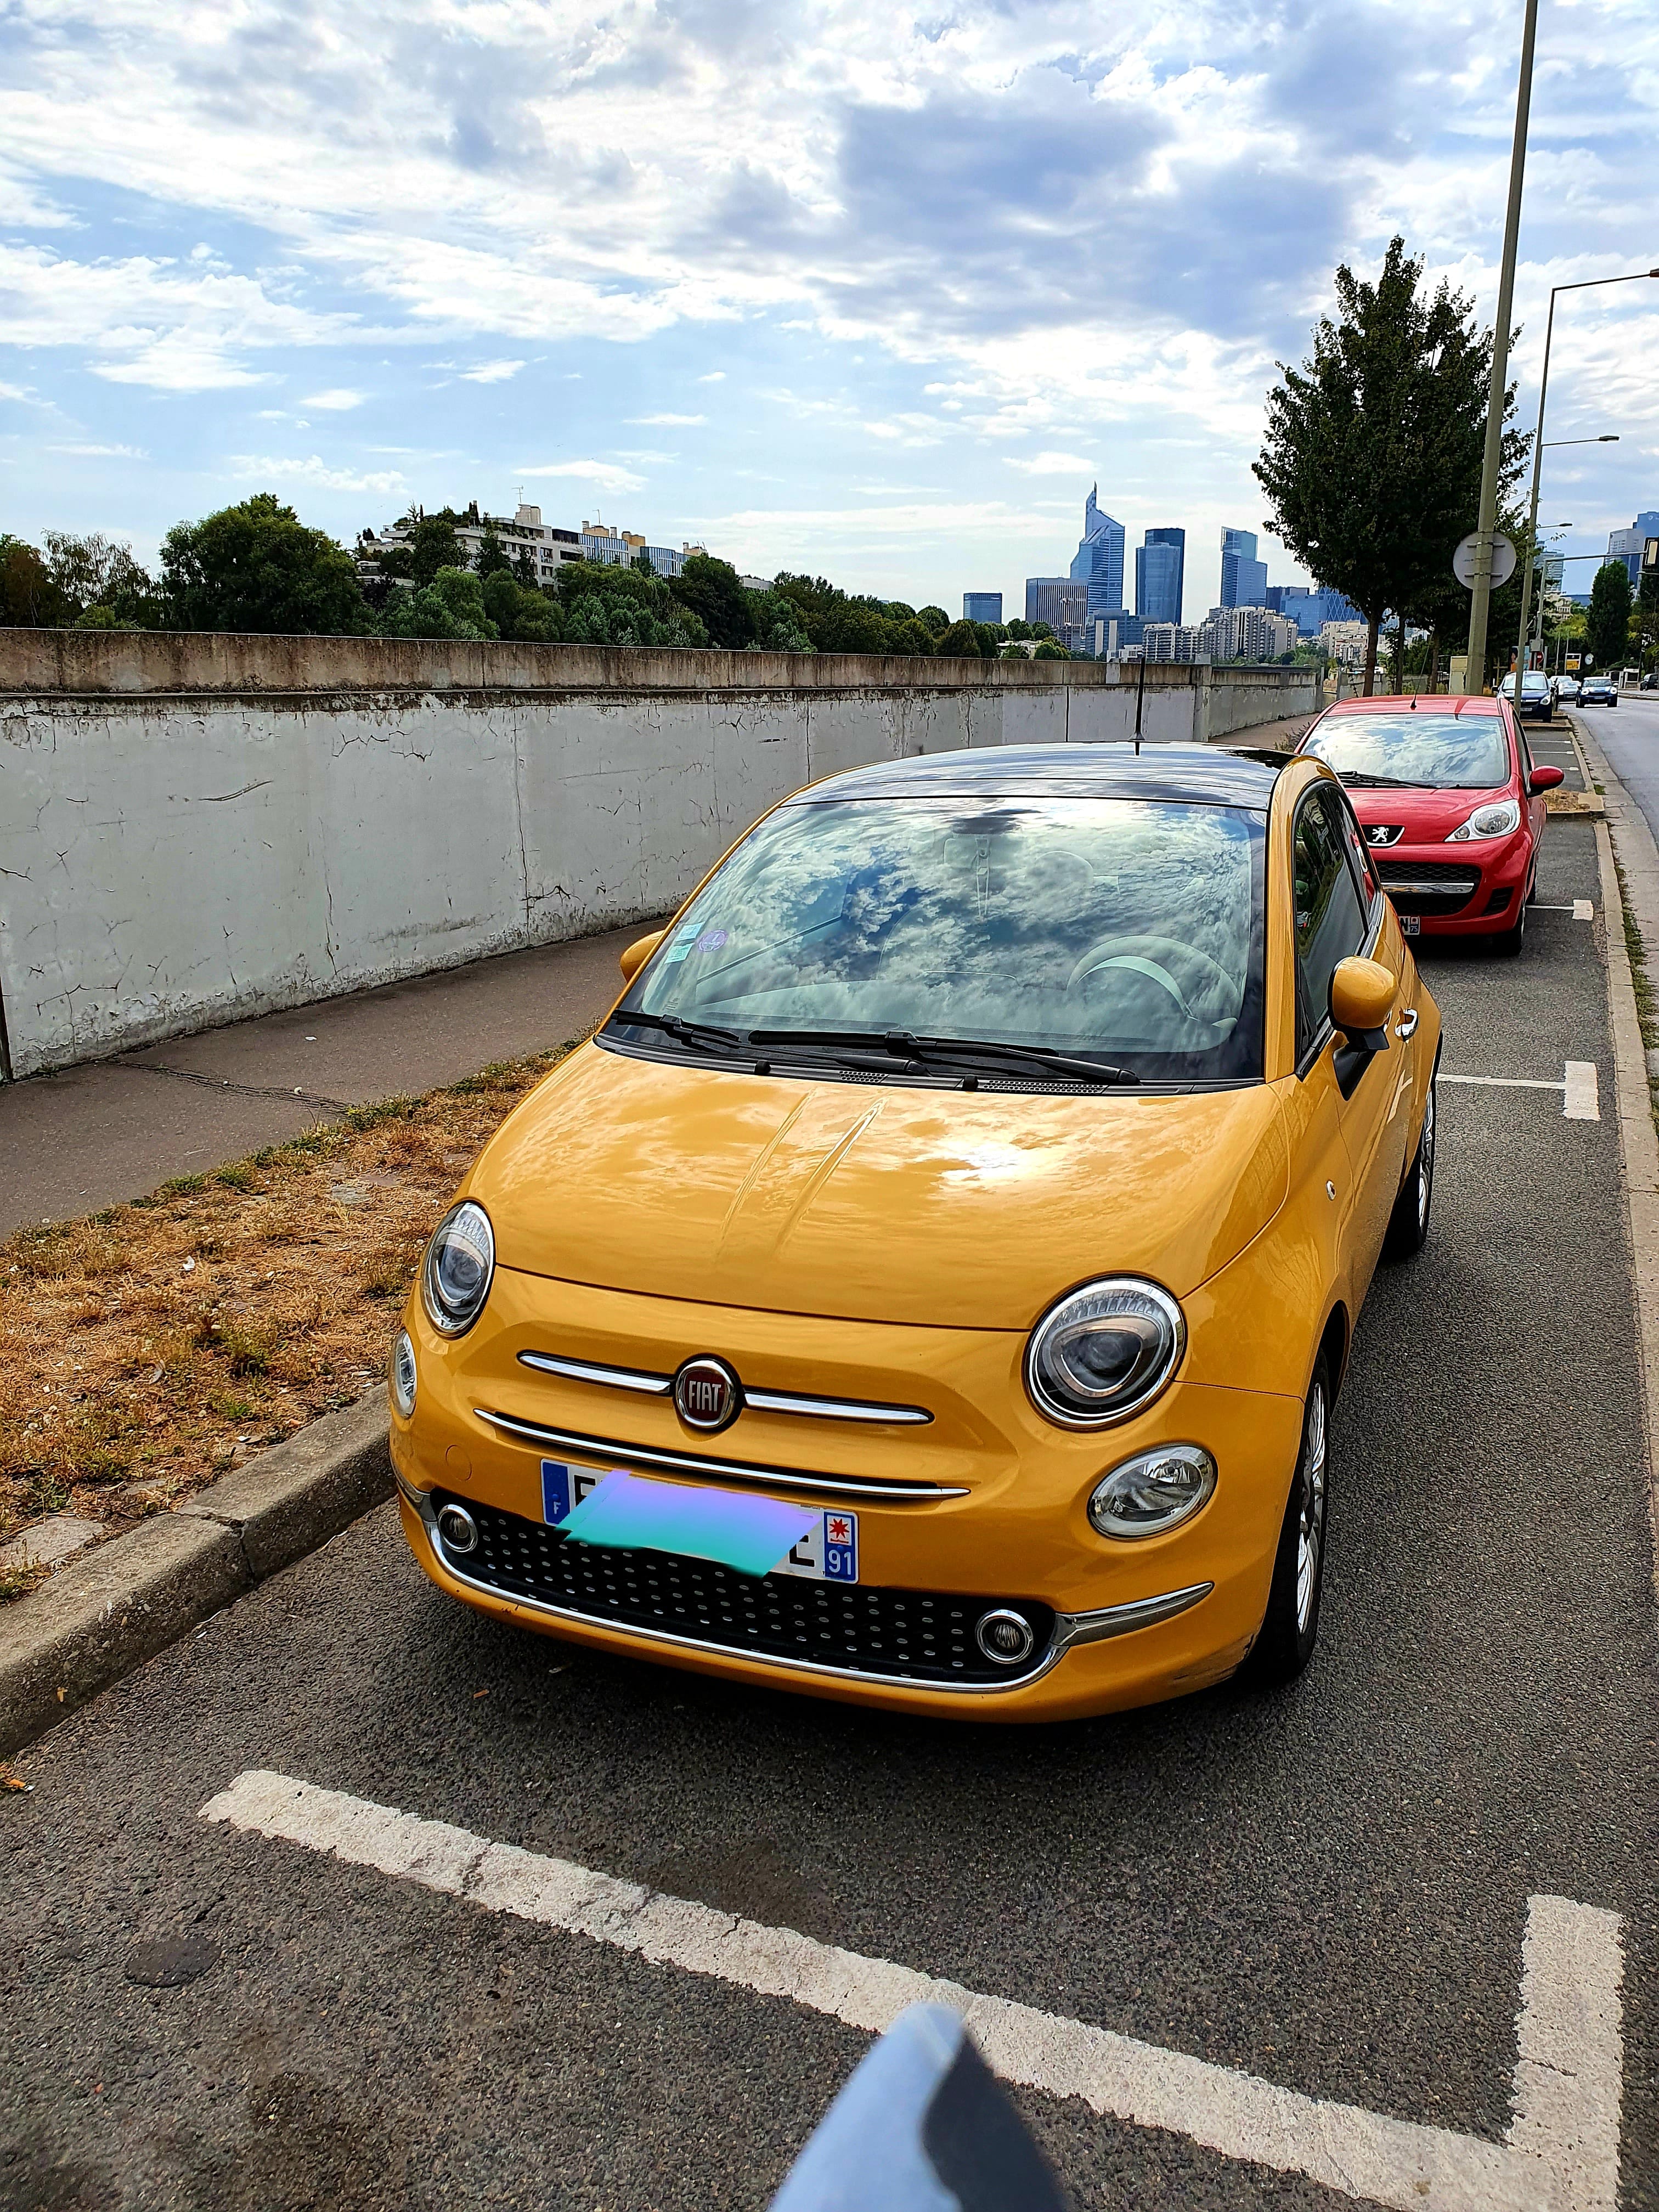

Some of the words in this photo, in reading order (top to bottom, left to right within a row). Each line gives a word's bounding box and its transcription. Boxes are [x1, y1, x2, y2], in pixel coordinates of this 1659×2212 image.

[689, 1380, 722, 1412] FIAT
[553, 1501, 561, 1515] F
[828, 1549, 851, 1576] 91
